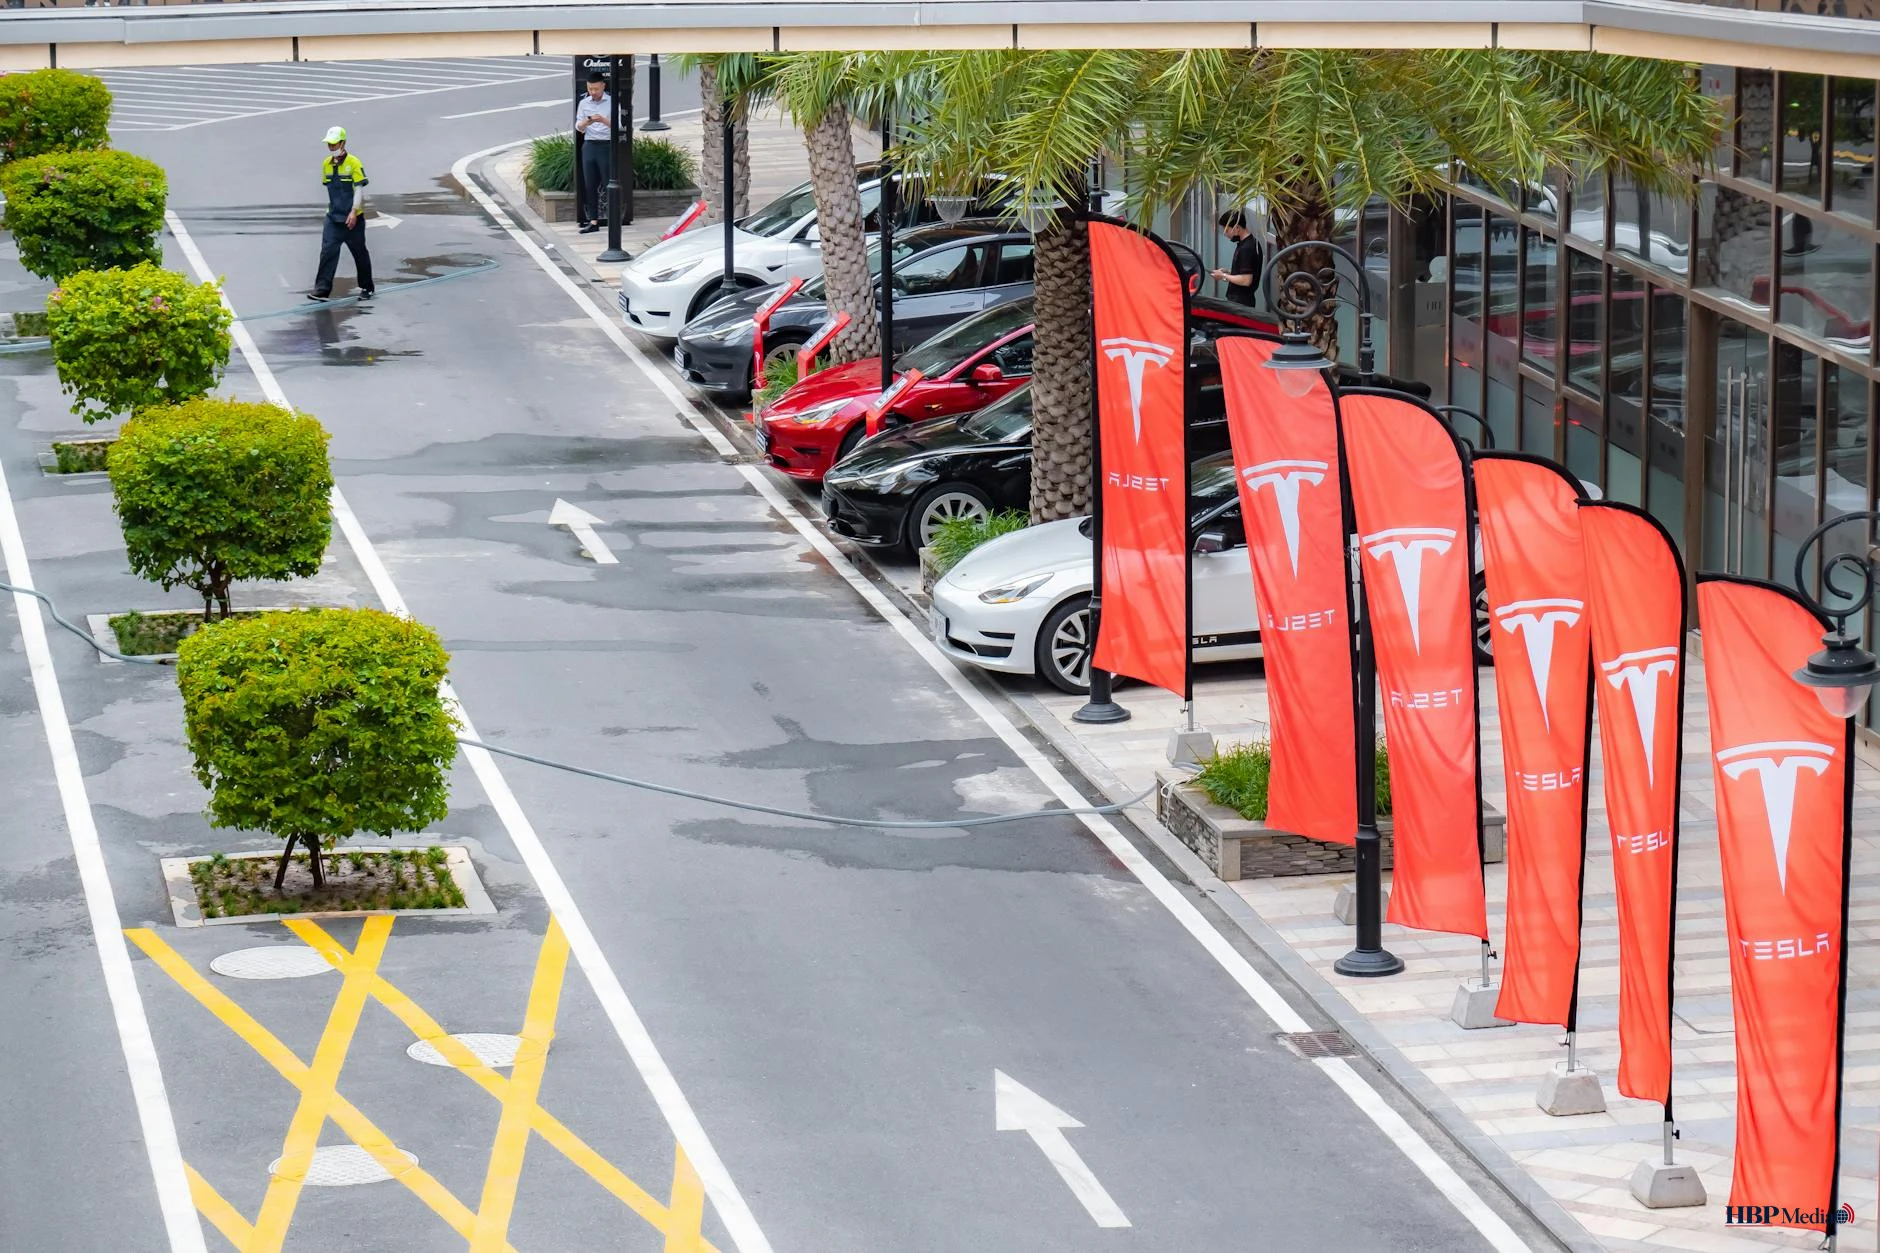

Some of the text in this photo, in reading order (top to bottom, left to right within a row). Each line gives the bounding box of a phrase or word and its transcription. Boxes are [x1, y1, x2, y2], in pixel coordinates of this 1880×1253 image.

[1515, 766, 1581, 792] ESLA
[1616, 829, 1671, 854] TESL
[1740, 932, 1830, 960] TESLA
